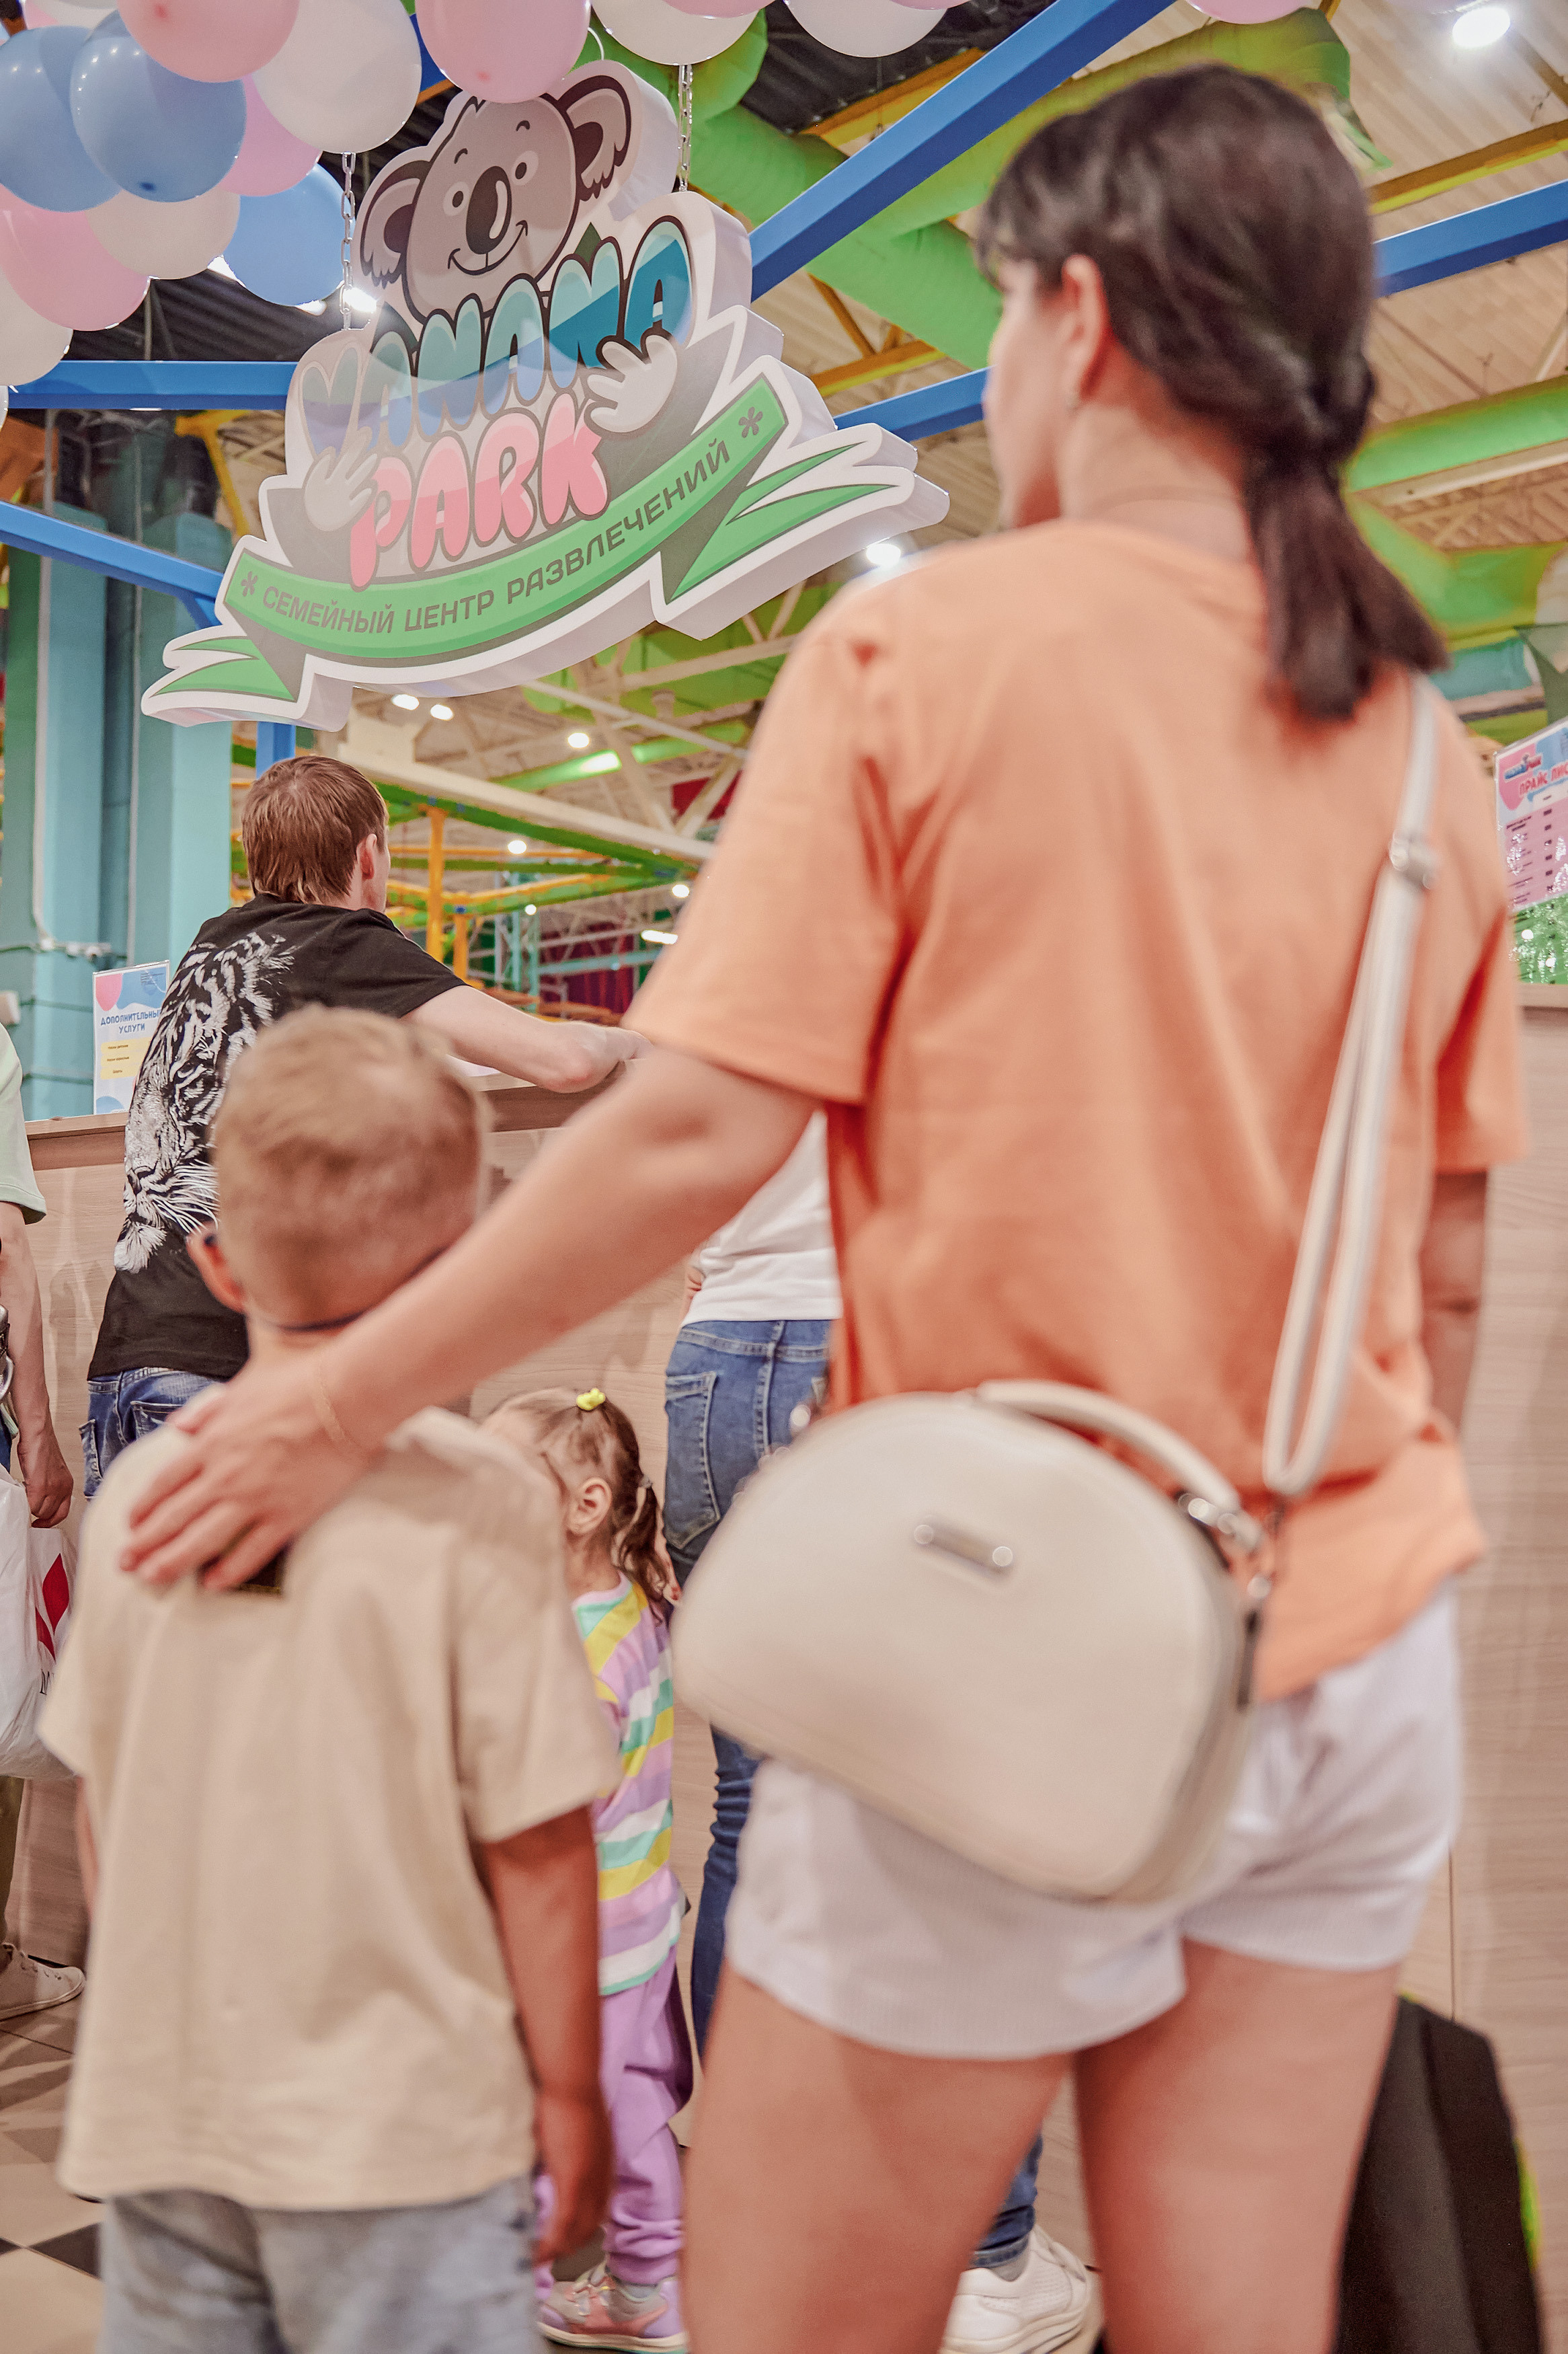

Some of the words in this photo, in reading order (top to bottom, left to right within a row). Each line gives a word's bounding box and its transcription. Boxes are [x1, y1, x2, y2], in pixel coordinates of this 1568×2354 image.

[262, 585, 395, 634] СЕМЕЙНЫЙ
[404, 589, 494, 632] ЦЕНТР
[507, 437, 731, 605] РАЗВЛЕЧЕНИЙ
[348, 389, 610, 591] PARK
[118, 1023, 145, 1034] УСЛУГИ
